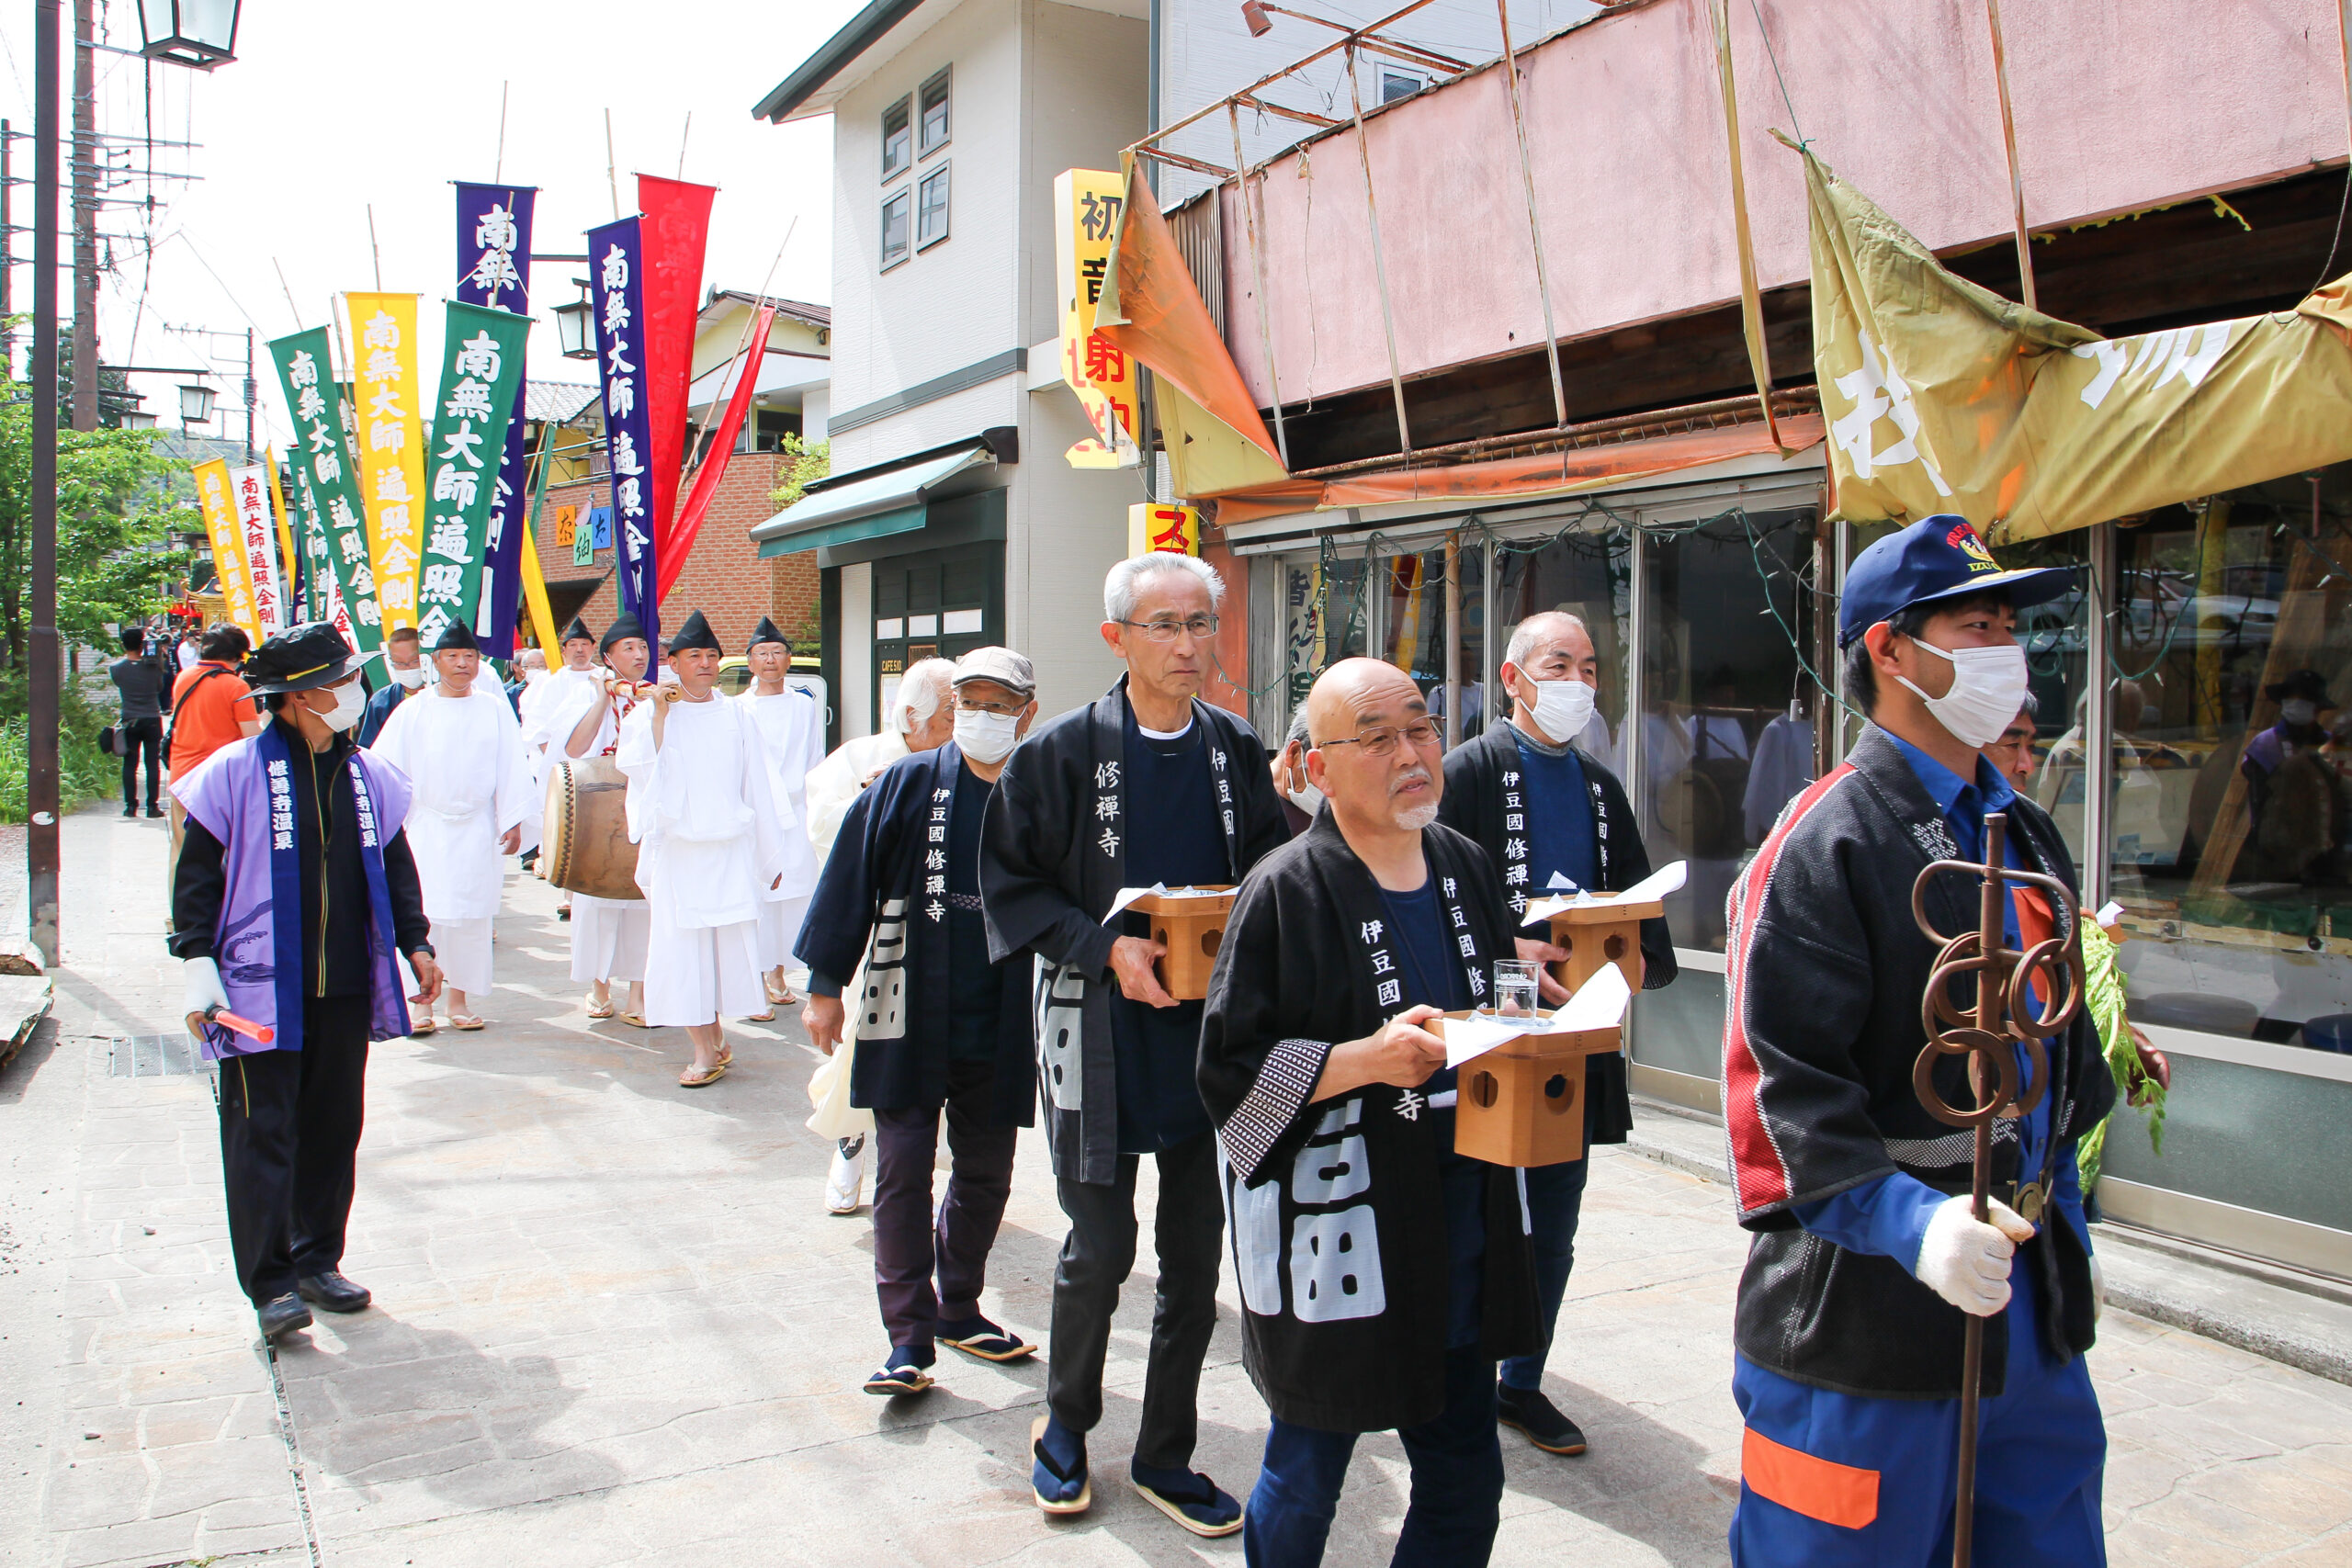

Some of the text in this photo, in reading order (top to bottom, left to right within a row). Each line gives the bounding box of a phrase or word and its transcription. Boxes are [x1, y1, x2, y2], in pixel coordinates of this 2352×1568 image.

[362, 309, 419, 611] 南無大師遍照金剛
[1153, 509, 1190, 554] ス
[241, 476, 277, 624] 南無大師遍照金剛
